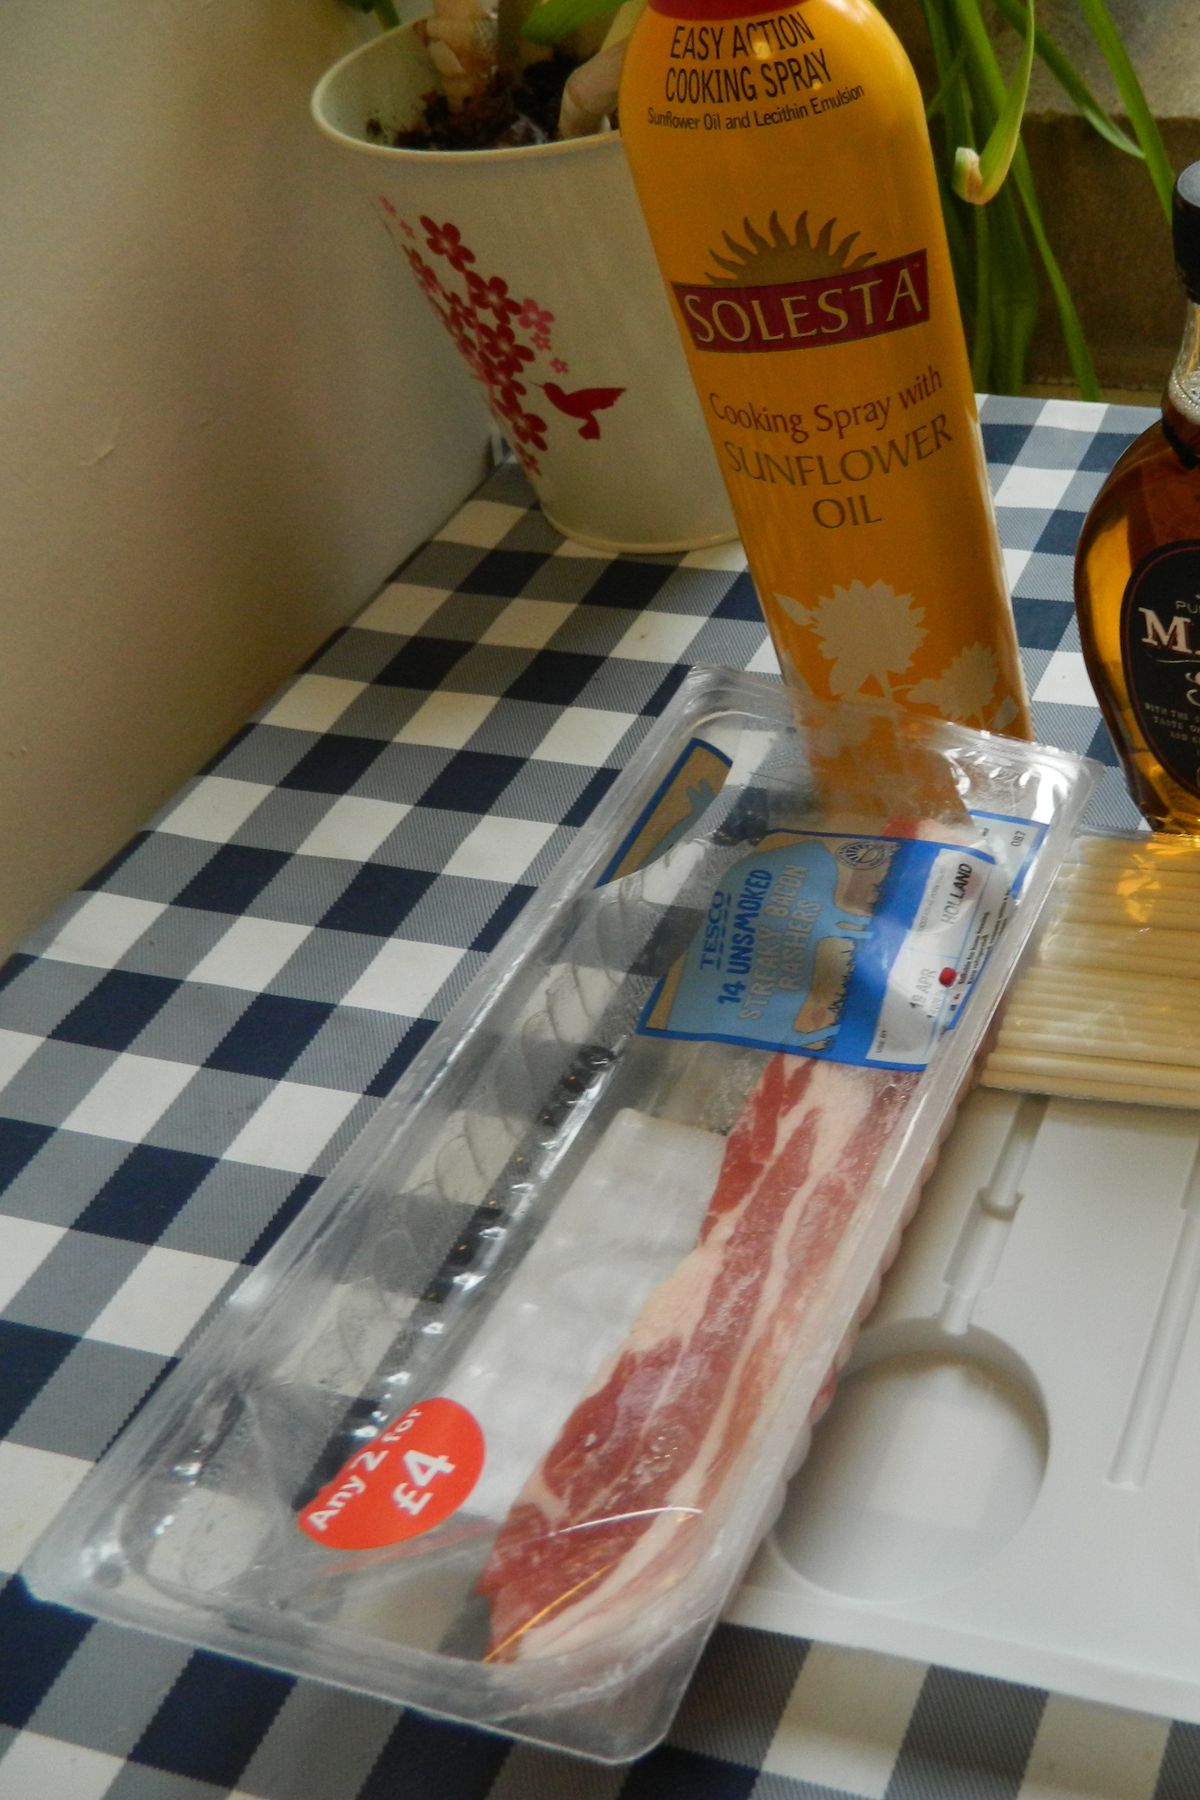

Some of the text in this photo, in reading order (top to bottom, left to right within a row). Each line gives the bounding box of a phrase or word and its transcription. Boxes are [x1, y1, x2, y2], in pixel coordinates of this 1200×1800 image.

[670, 11, 815, 60] EASY ACTION
[647, 83, 865, 131] Sunflower Oil and Lecithin Emulsion
[665, 48, 833, 105] COOKING SPRAY
[684, 269, 923, 344] SOLESTA
[709, 365, 943, 444] Cooking Spray with
[723, 413, 954, 486] SUNFLOWER
[812, 494, 882, 529] OIL
[700, 890, 725, 970] TESCO
[941, 862, 973, 926] HOLLAND
[717, 869, 773, 1004] 14 UNSMOKED
[737, 863, 808, 1020] STREAKY BACON
[778, 898, 822, 992] RASHERS
[308, 1409, 422, 1531] Any 2 for
[393, 1449, 456, 1517] £4
